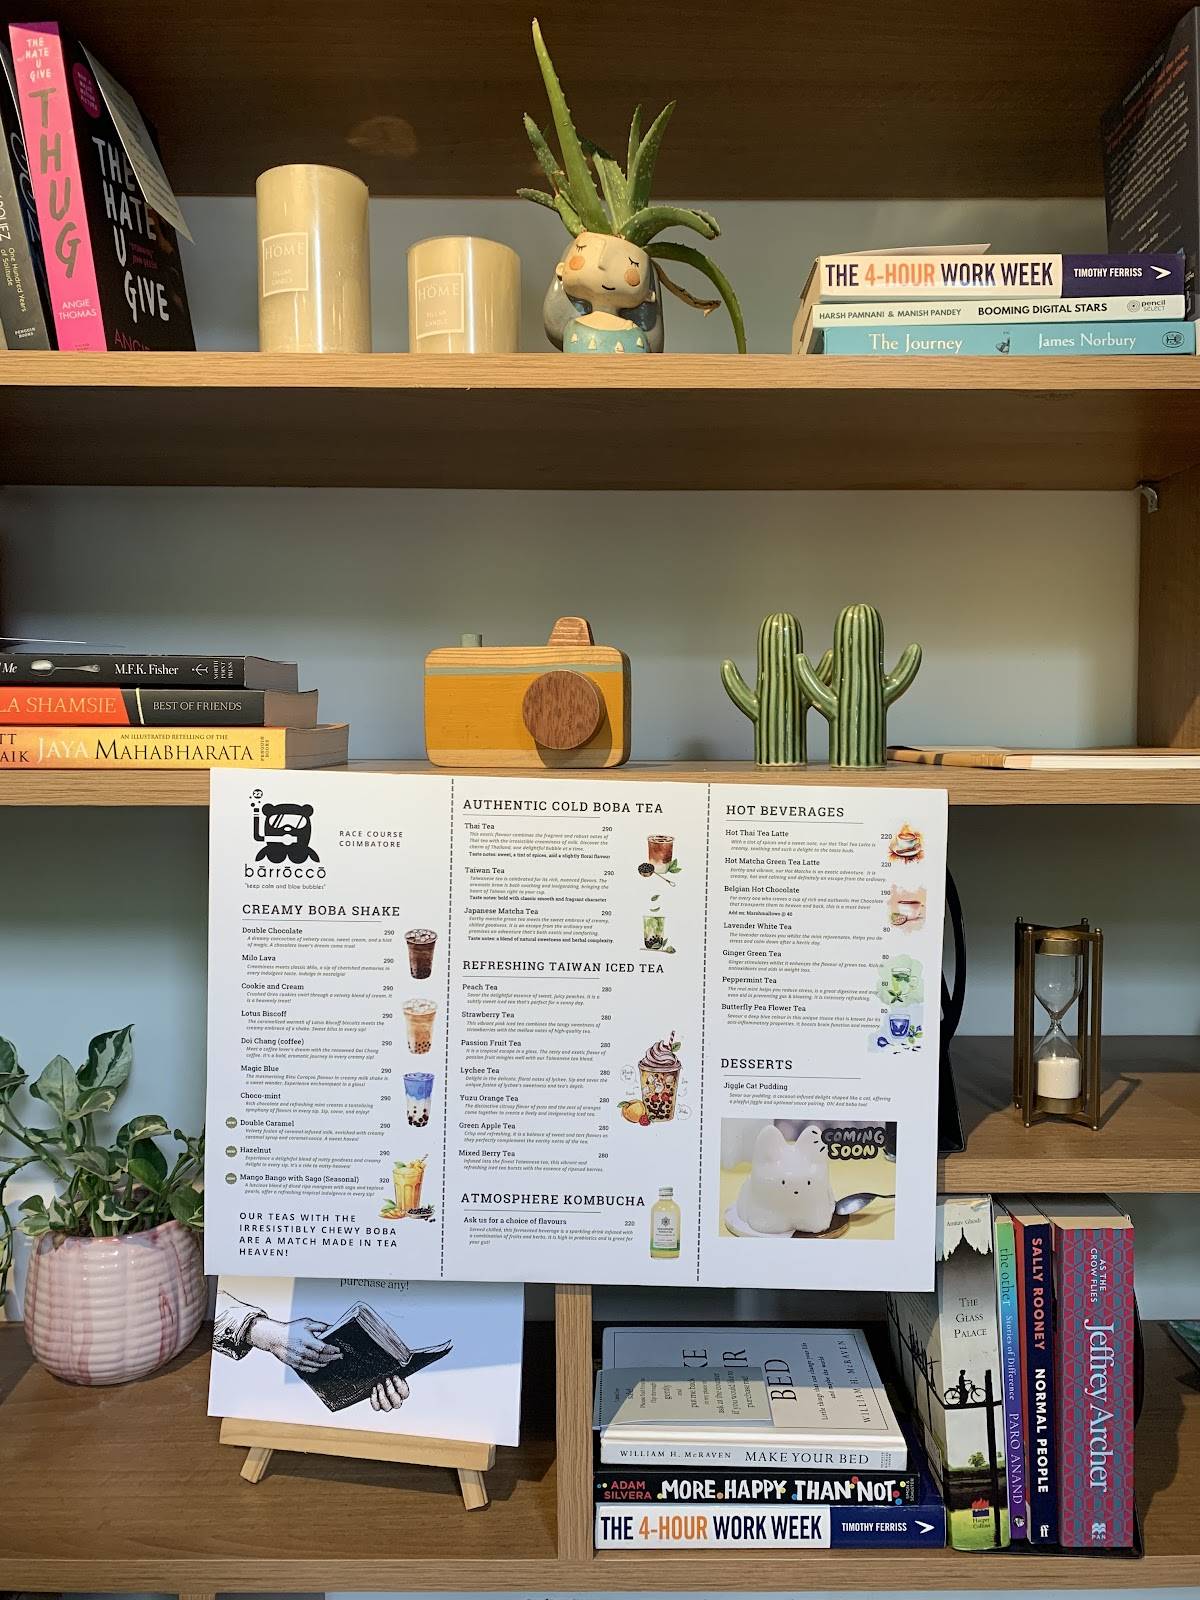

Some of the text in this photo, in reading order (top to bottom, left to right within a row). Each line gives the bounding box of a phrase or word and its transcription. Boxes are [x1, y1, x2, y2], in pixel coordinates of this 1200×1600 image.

[26, 39, 44, 47] THE
[25, 48, 49, 58] HATE
[36, 60, 42, 68] U
[30, 69, 51, 81] GIVE
[92, 136, 137, 192] THE
[103, 181, 157, 241] HATE
[115, 227, 127, 268] U
[825, 262, 1053, 287] THE 4-HOUR WORK WEEK
[1074, 267, 1142, 278] TIMOTHY FERRISS
[125, 271, 169, 323] GIVE
[62, 299, 92, 309] ANGIE
[978, 303, 1107, 316] BOOMING DIGITAL STARS
[1141, 300, 1166, 308] pencil
[59, 309, 97, 320] THOMAS
[819, 312, 846, 320] HARSH
[848, 311, 884, 319] PAMNANI
[897, 309, 928, 318] MANISH
[931, 309, 961, 317] PANDEY
[869, 333, 962, 353] The Journey
[1039, 332, 1136, 349] James Norbury
[2, 662, 17, 673] Me
[115, 663, 179, 674] M.F.K. Fisher
[26, 697, 116, 713] SHAMSIE
[153, 701, 241, 711] BEST OF FRIENDS
[38, 737, 88, 764] JAYA
[96, 740, 254, 760] MAHABHARATA
[463, 800, 663, 813] AUTHENTIC COLD BOBA TEA
[727, 805, 844, 817] HOT BEVERAGES
[242, 905, 400, 916] CREAMY BOBA SHAKE
[463, 961, 664, 973] REFRESHING TAIWAN ICED TEA
[721, 1059, 793, 1069] DESSERTS
[824, 1129, 884, 1144] COMING
[830, 1145, 874, 1157] SOON
[461, 1193, 645, 1206] ATMOSPHERE KOMBUCHA
[269, 1213, 295, 1221] TEAS
[301, 1214, 329, 1222] WITH
[240, 1225, 315, 1234] IRRESISTIBLY
[277, 1237, 317, 1245] MATCH
[1099, 1259, 1106, 1272] AS
[1000, 1248, 1014, 1307] the other
[340, 1278, 409, 1290] purchase any!
[1032, 1238, 1044, 1350] SALLY ROONEY
[959, 1298, 978, 1307] THE
[956, 1313, 984, 1322] GLASS
[954, 1329, 987, 1338] PALACE
[1005, 1315, 1015, 1400] Stories of Difference
[764, 1359, 797, 1401] BED
[1085, 1319, 1114, 1492] Jeffrey Archer
[1035, 1368, 1048, 1493] NORMAL PEOPLE
[684, 1451, 732, 1459] McRAVEN
[745, 1451, 788, 1463] MAKE
[792, 1452, 834, 1464] YOUR
[839, 1453, 869, 1464] BED
[1009, 1413, 1022, 1504] PARO ANAND
[611, 1481, 645, 1489] ADAM
[661, 1480, 896, 1501] MORE HAPPY THAN NOT
[604, 1491, 652, 1499] SILVERA
[601, 1515, 821, 1540] THE 4-HOUR WORK WEEK
[842, 1522, 907, 1532] TIMOTHY FERRISS
